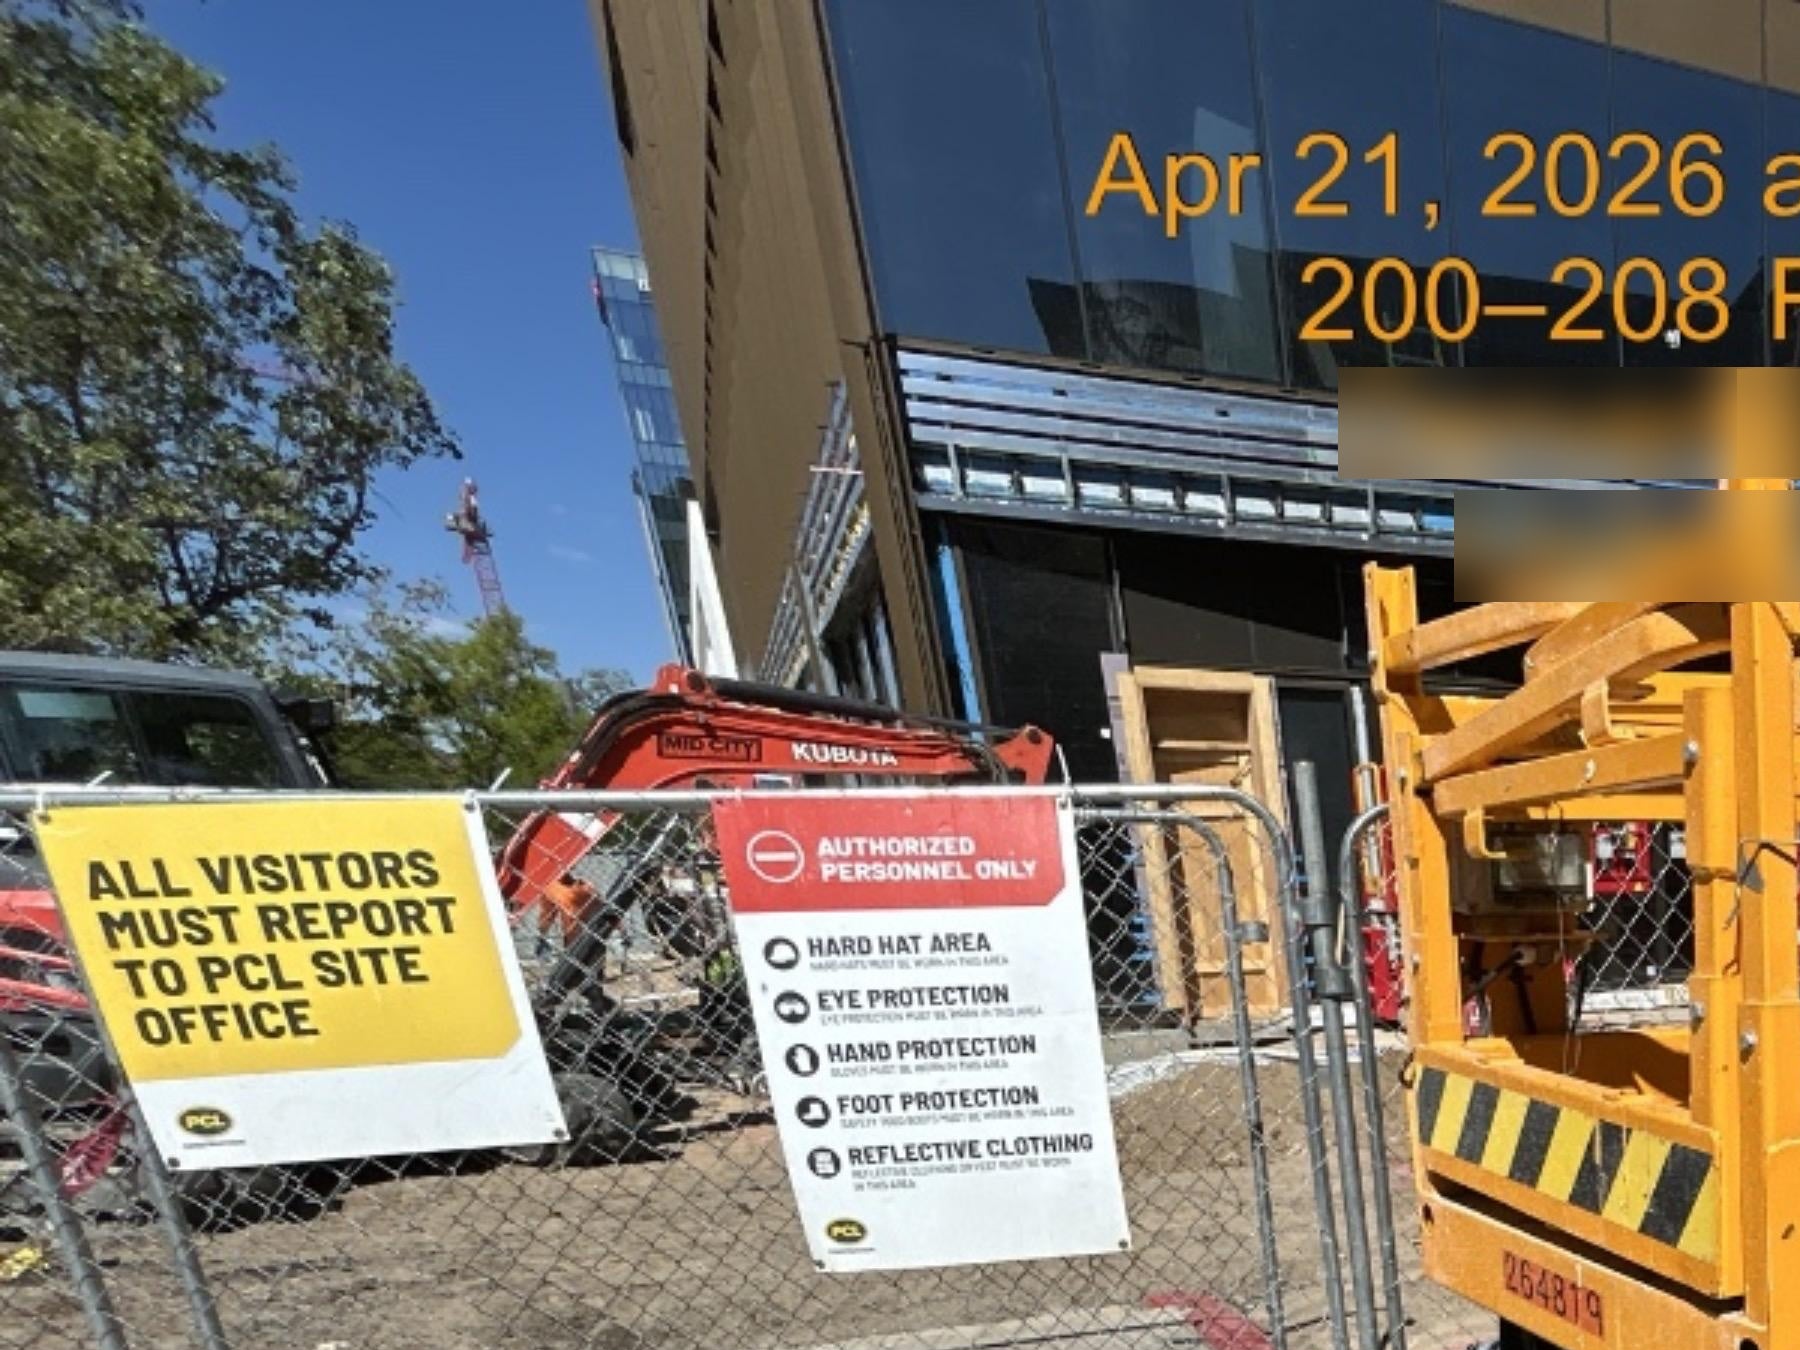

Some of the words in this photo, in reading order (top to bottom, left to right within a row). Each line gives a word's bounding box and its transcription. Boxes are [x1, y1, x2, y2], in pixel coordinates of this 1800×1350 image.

[816, 834, 977, 860] AUTHORIZED
[88, 856, 192, 902] ALL
[195, 848, 441, 896] VISITORS
[821, 858, 974, 884] PERSONNEL
[976, 857, 1039, 882] ONLY
[96, 904, 241, 951] MUST
[256, 895, 458, 945] REPORT
[806, 935, 874, 958] HARD
[878, 933, 923, 957] HAT
[929, 931, 992, 954] AREA
[114, 958, 187, 1000] TO
[200, 953, 305, 996] PCL
[311, 945, 430, 989] SITE
[816, 987, 864, 1012] EYE
[865, 983, 1010, 1009] PROTECTION
[134, 998, 321, 1049] OFFICE
[826, 1040, 893, 1064] HAND
[895, 1034, 1038, 1061] PROTECTION
[836, 1093, 895, 1116] FOOT
[899, 1084, 1040, 1112] PROTECTION
[847, 1139, 983, 1167] REFLECTIVE
[985, 1132, 1095, 1159] CLOTHING
[1503, 1250, 1606, 1337] 264819
